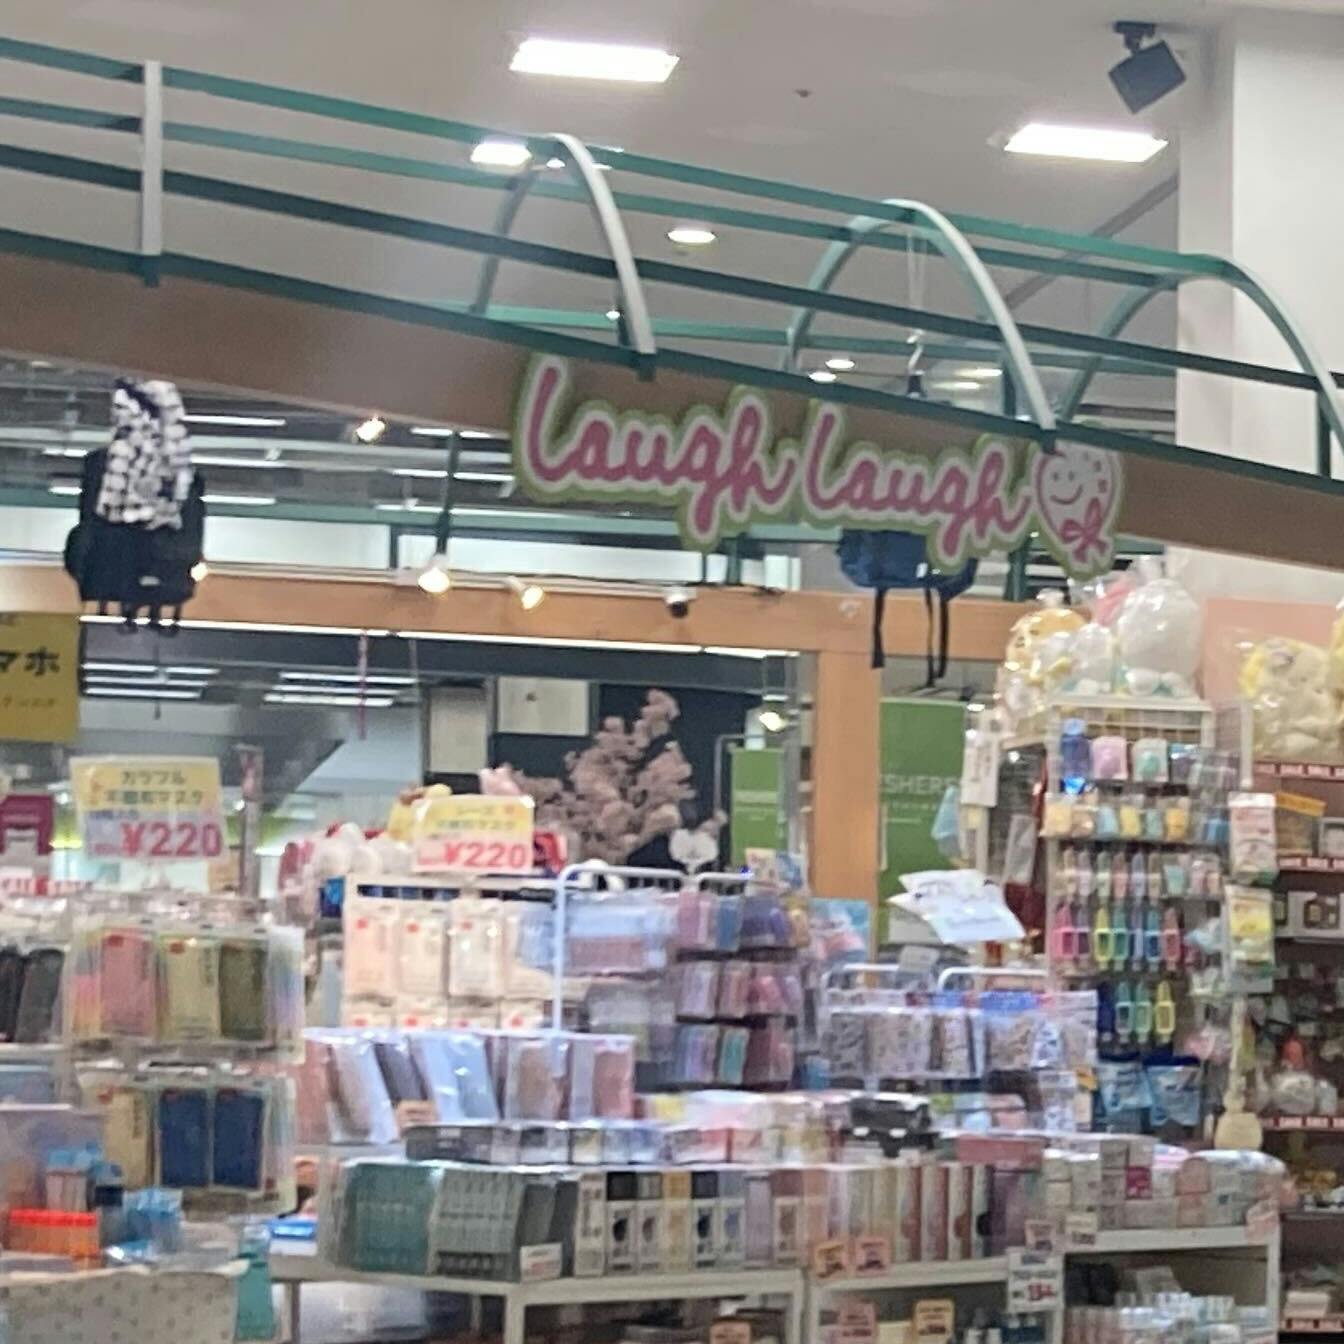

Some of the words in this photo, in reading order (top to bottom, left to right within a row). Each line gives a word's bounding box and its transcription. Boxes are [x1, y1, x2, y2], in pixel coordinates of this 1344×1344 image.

[526, 364, 796, 533] Laugh
[804, 410, 1031, 557] Laugh
[120, 821, 223, 858] ¥220
[444, 842, 527, 868] ¥220
